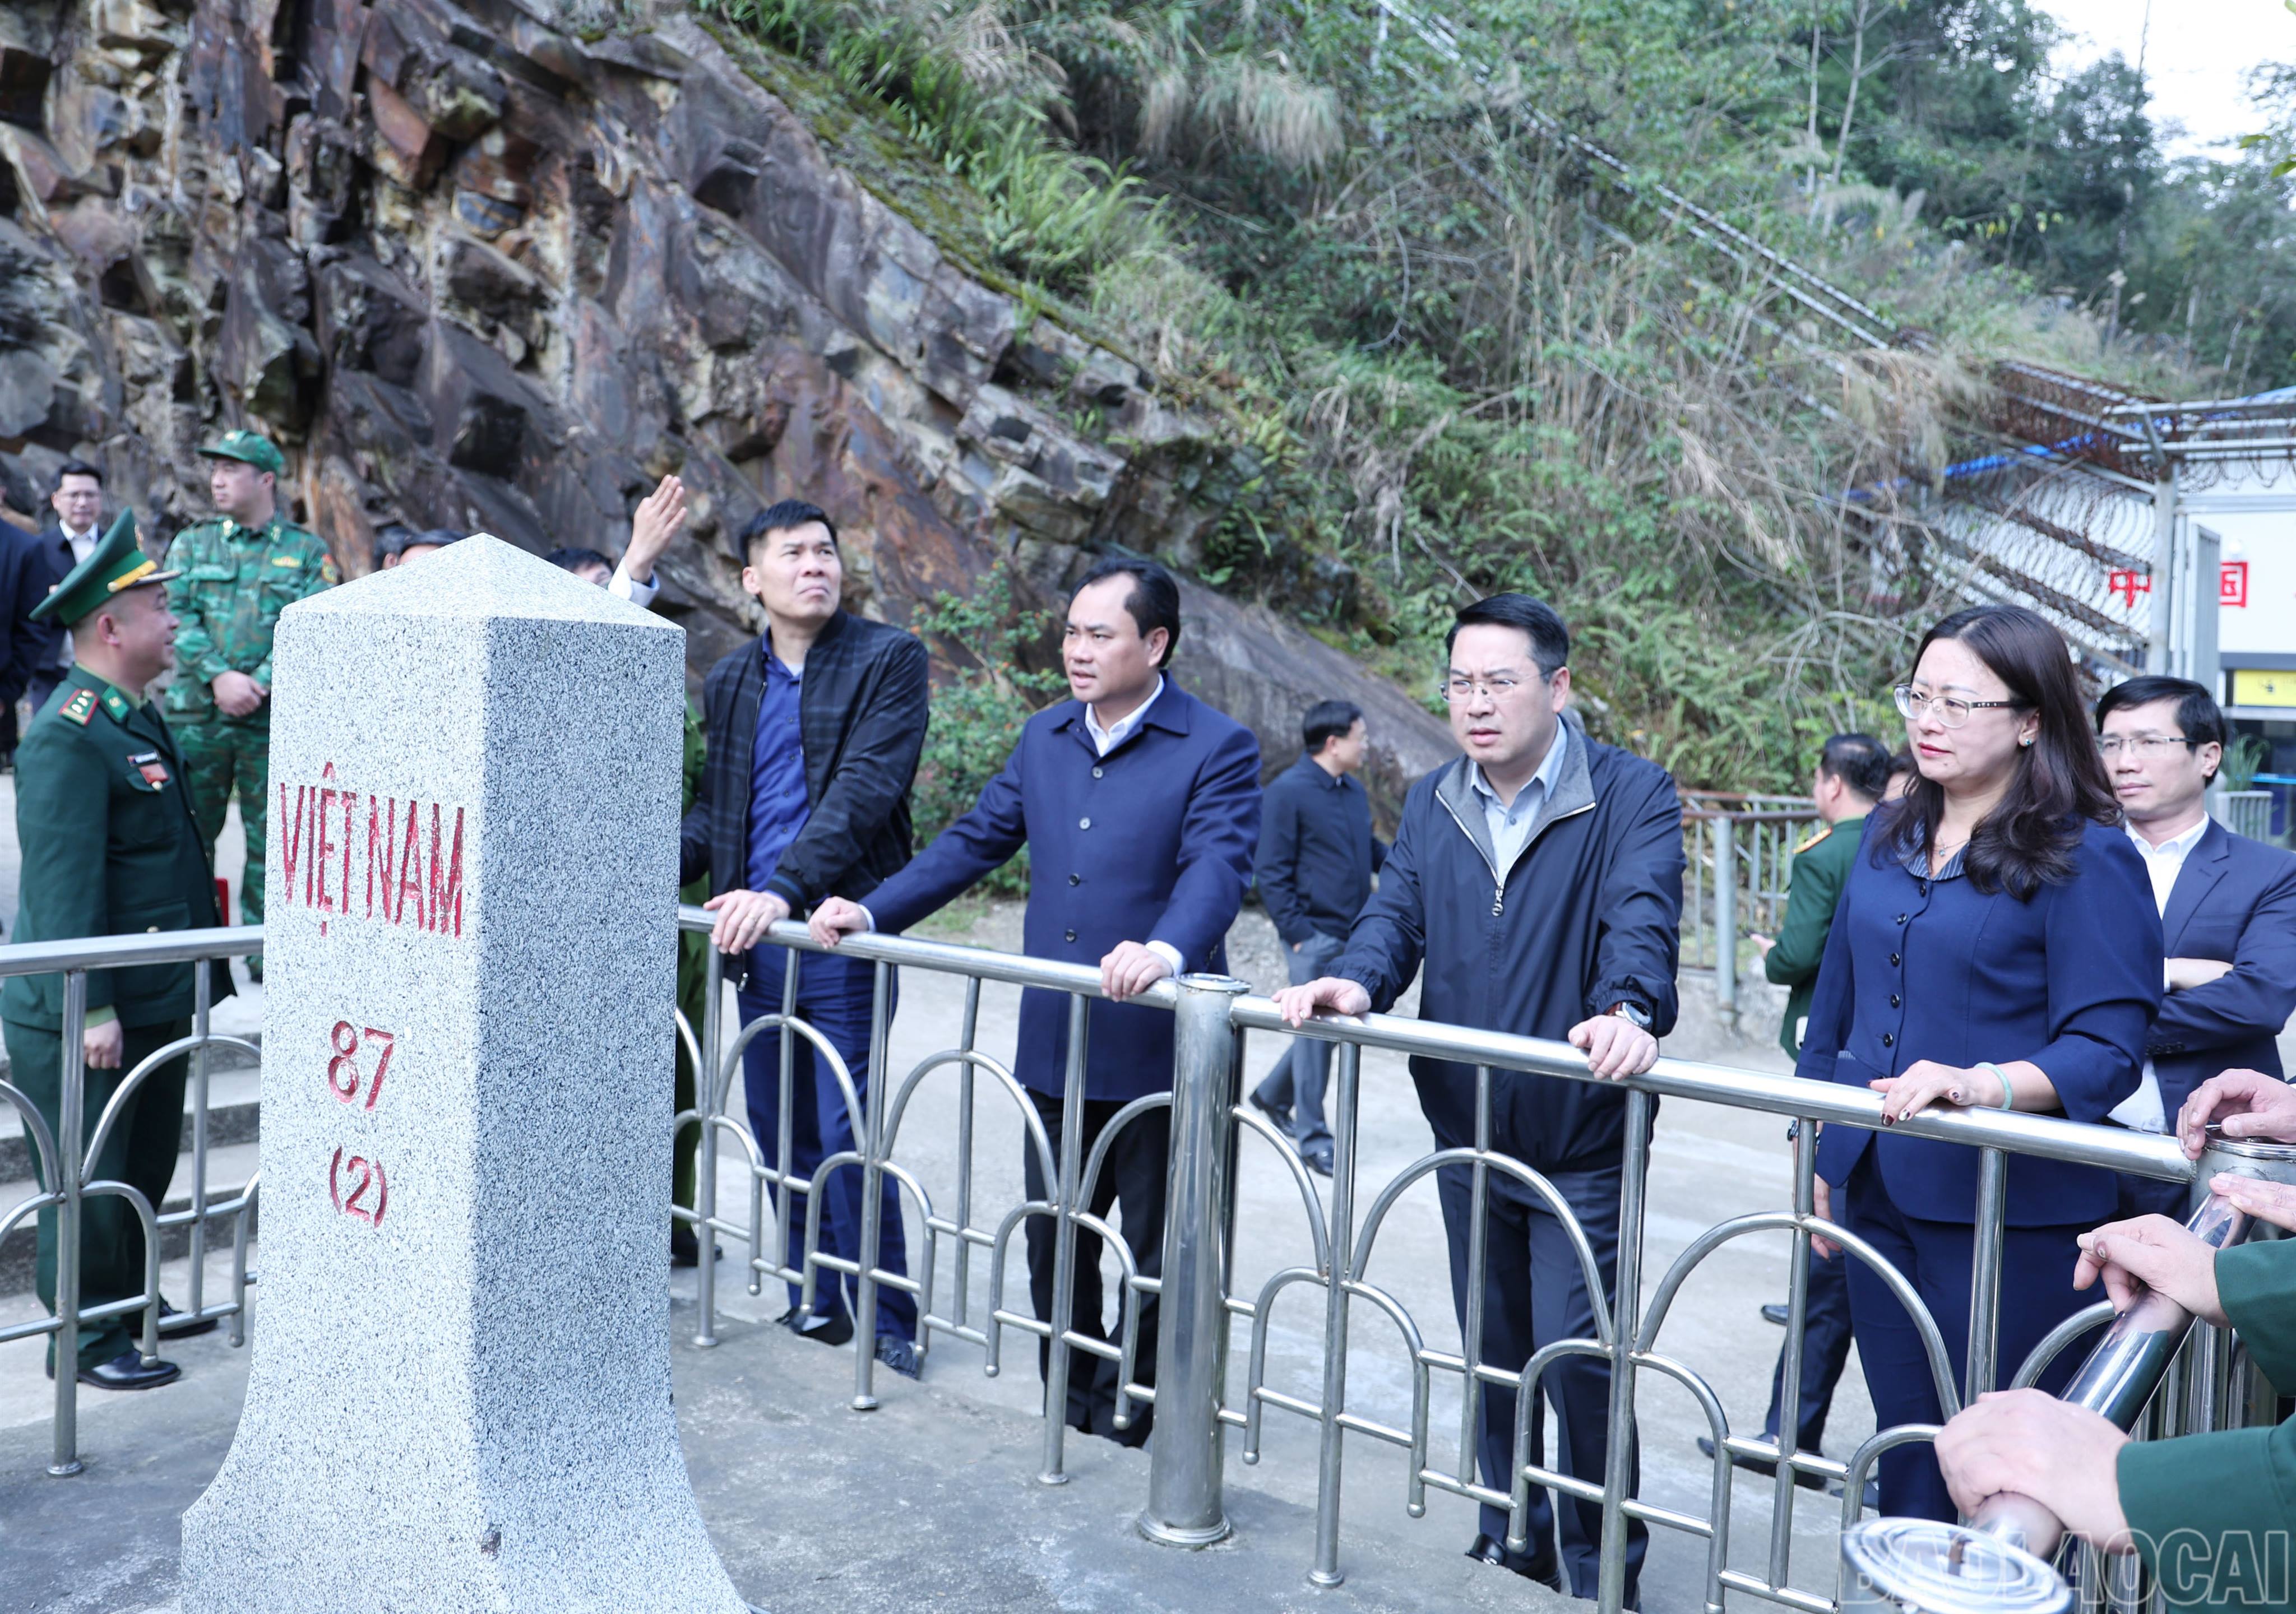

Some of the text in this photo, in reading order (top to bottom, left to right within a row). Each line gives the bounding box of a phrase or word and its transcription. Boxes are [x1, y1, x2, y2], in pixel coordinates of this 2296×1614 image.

[280, 762, 465, 939] VIỆT NAM
[328, 1020, 394, 1111] 87
[328, 1145, 387, 1227] (2)
